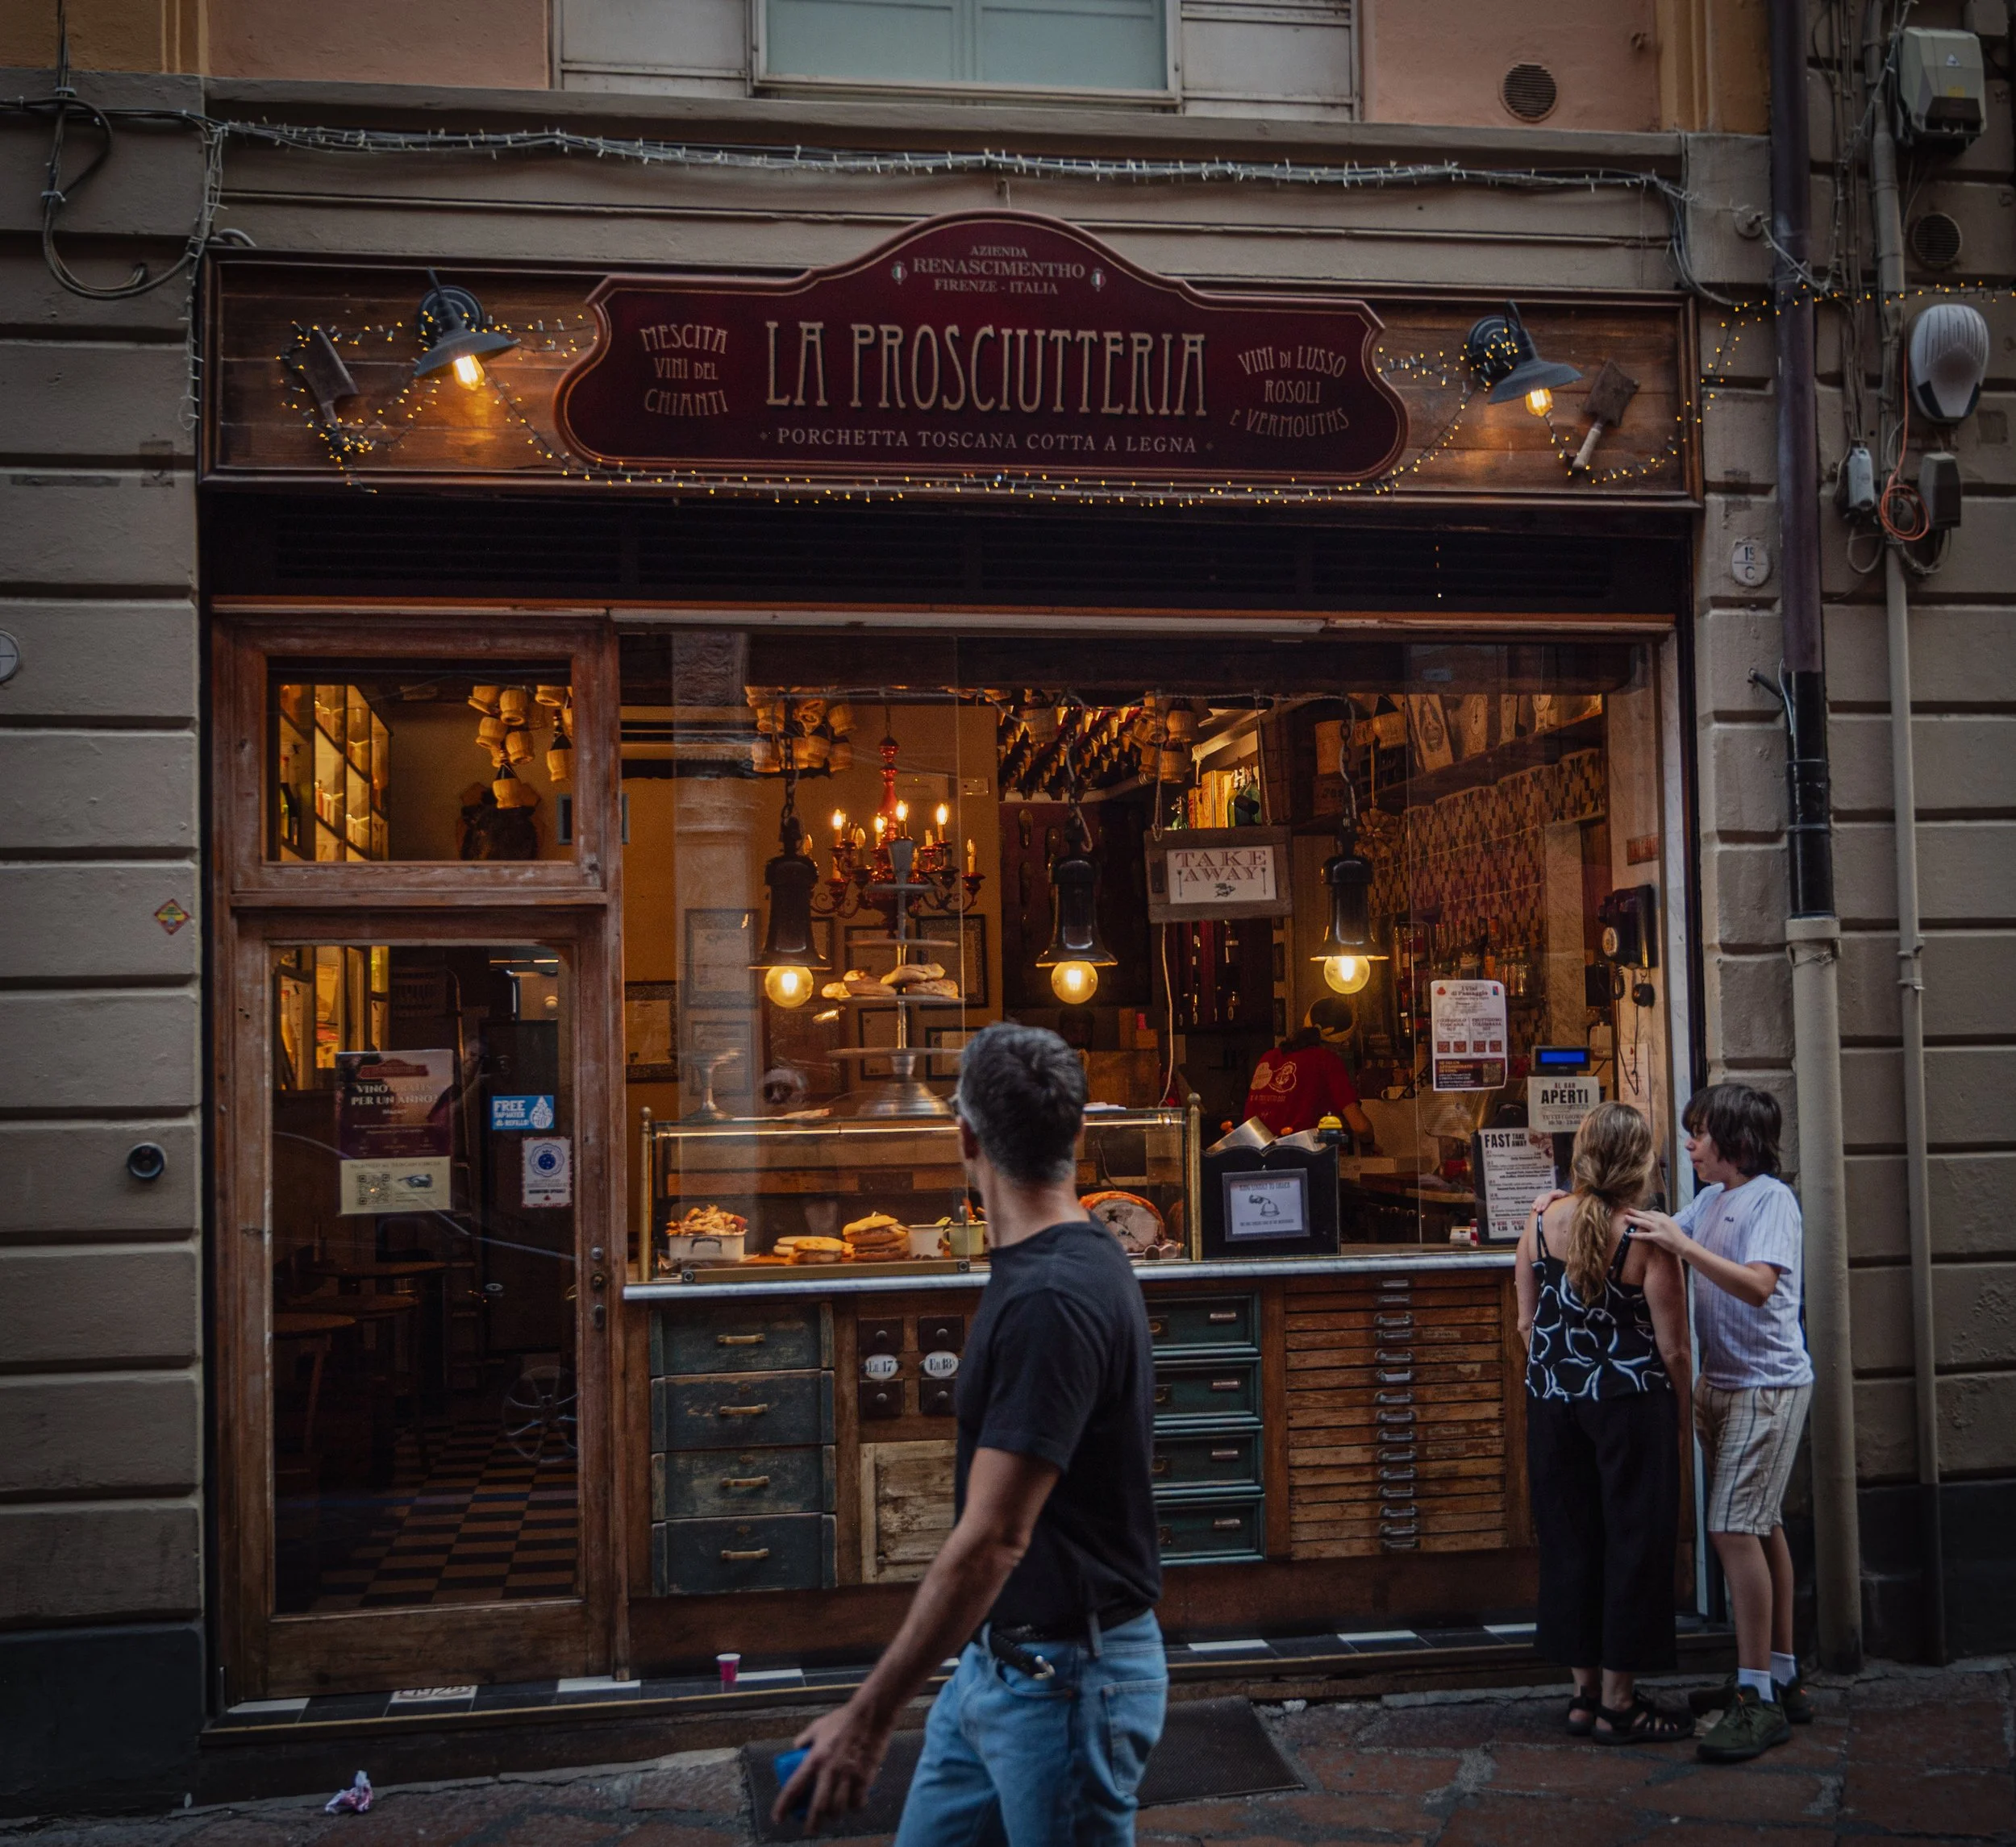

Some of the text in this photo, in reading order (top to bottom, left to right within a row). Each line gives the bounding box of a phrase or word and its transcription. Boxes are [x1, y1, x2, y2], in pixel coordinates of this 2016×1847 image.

[970, 245, 1028, 258] AZIENDA
[913, 258, 1085, 279] RENASCIMENTHO
[934, 278, 998, 293] FIRENZE
[1010, 281, 1059, 295] ITALIA
[639, 323, 729, 355] MESCITA
[654, 357, 689, 380] VINI
[765, 321, 1207, 417] LA PROSCIUTTERIA
[1237, 346, 1275, 376] VINI
[1296, 345, 1347, 378] LUSSO
[1264, 380, 1322, 404] ROSOLI
[645, 389, 729, 417] CHIANTI
[1229, 407, 1349, 437] E VERMOUTHS
[777, 428, 1198, 453] PORCHETTA TOSCANA COTTA A LEGNA
[1745, 566, 1756, 580] C
[1175, 851, 1267, 868] TAKE
[1183, 867, 1258, 882] AWAY
[356, 1084, 388, 1093] VINO
[1541, 1089, 1588, 1104] APERTI
[350, 1096, 374, 1106] PER
[376, 1096, 395, 1105] UN
[494, 1100, 526, 1111] FREE
[1484, 1134, 1510, 1148] FAST
[883, 1359, 893, 1372] 17
